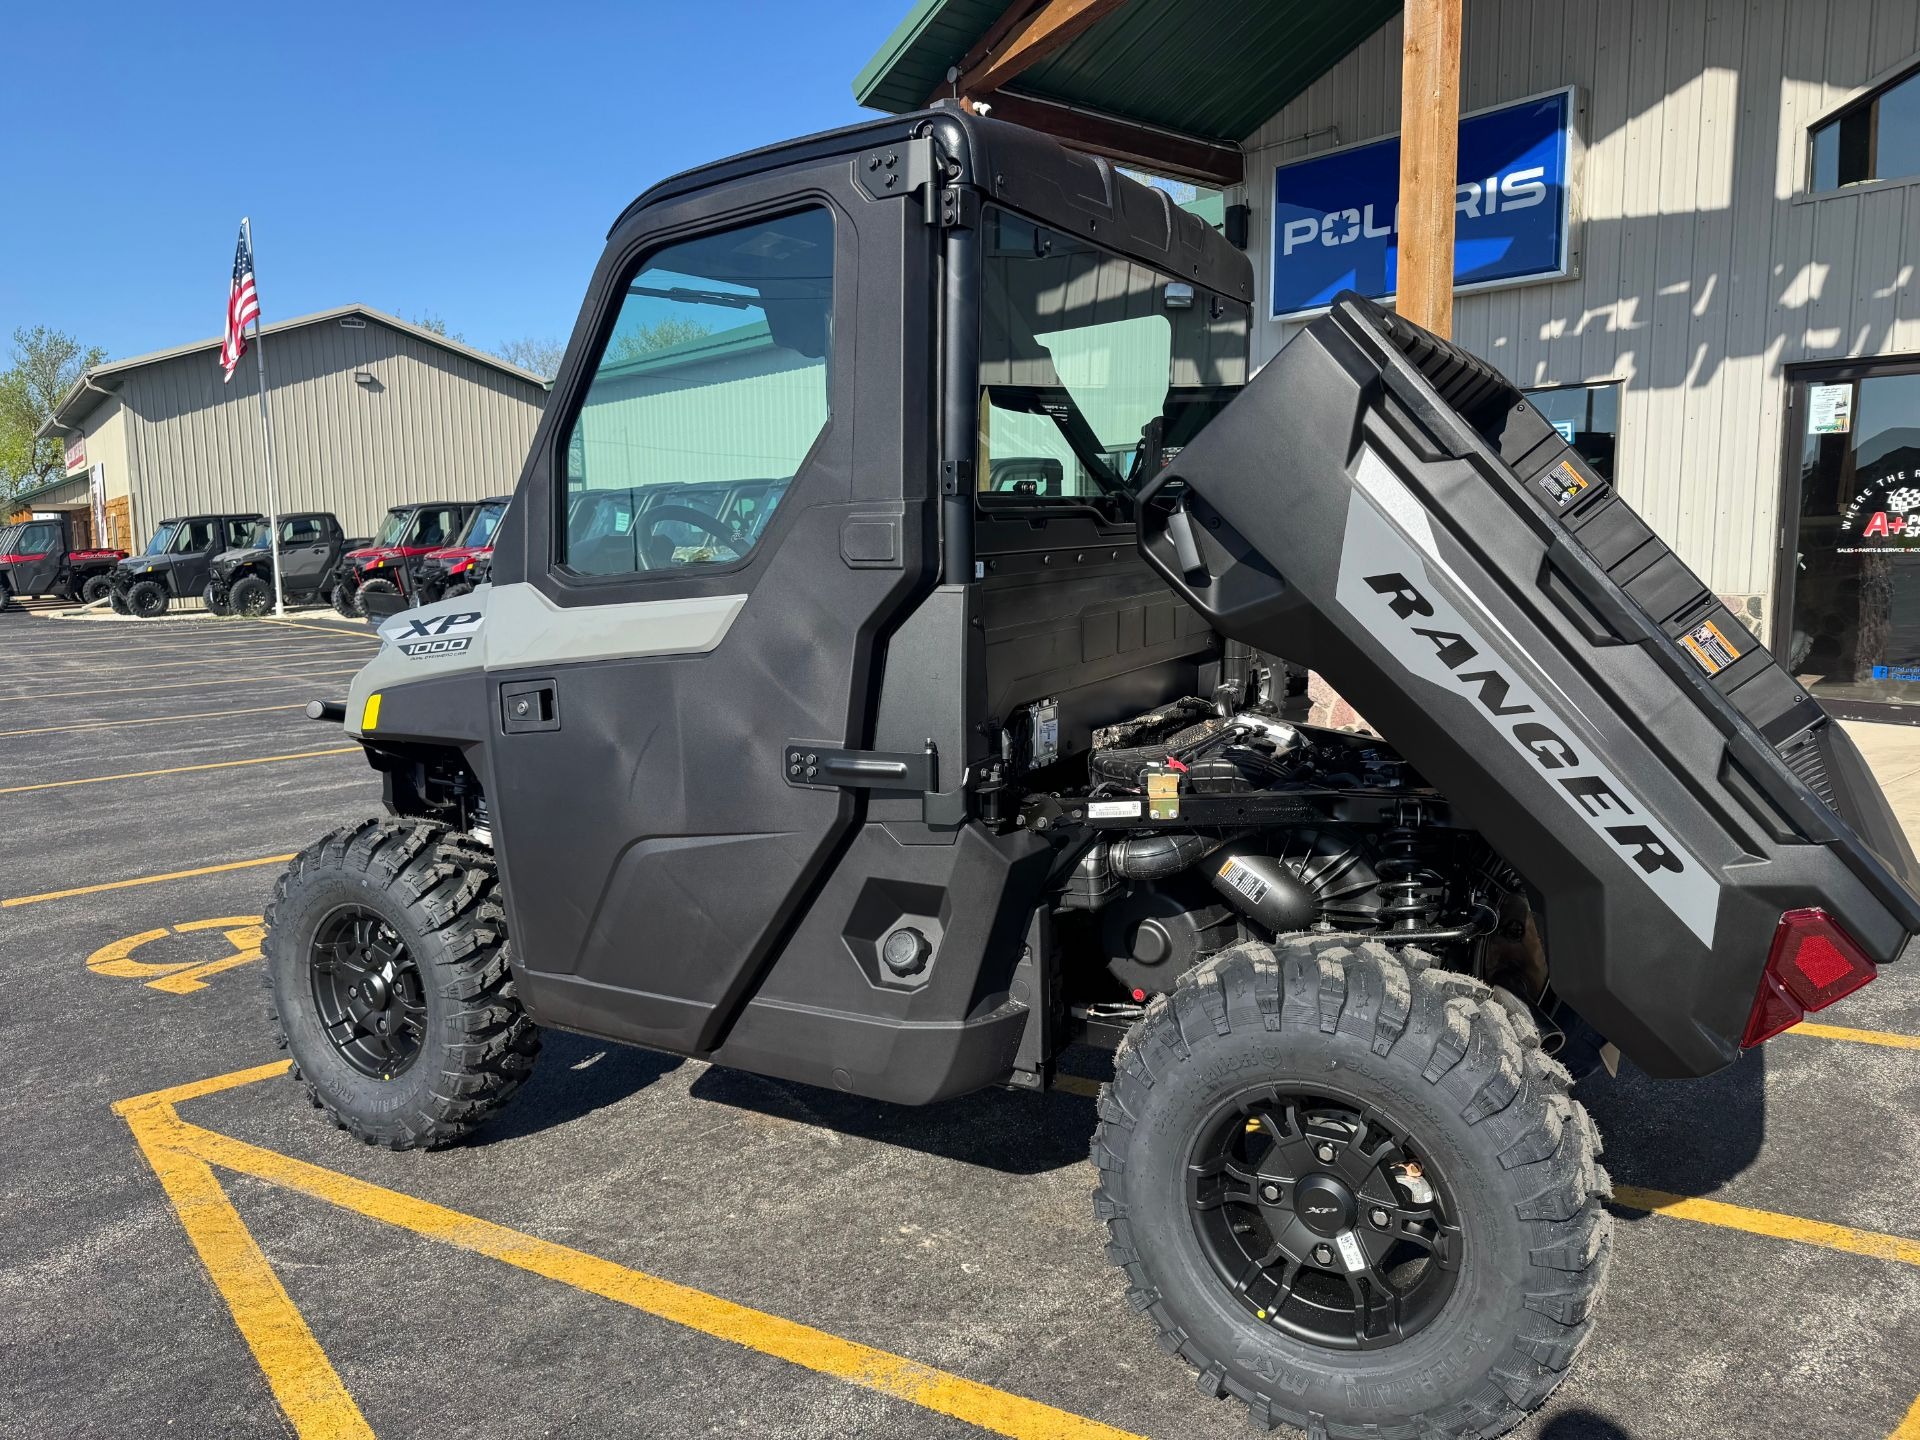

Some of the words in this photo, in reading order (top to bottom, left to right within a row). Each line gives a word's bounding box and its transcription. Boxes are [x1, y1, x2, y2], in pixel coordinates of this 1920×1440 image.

[1283, 166, 1547, 256] POLRIS
[1841, 488, 1873, 530] WHERE
[1876, 471, 1906, 487] THE
[1863, 511, 1907, 537] A+
[395, 611, 482, 640] XP
[408, 640, 467, 655] 1000
[1362, 572, 1685, 875] RANGER
